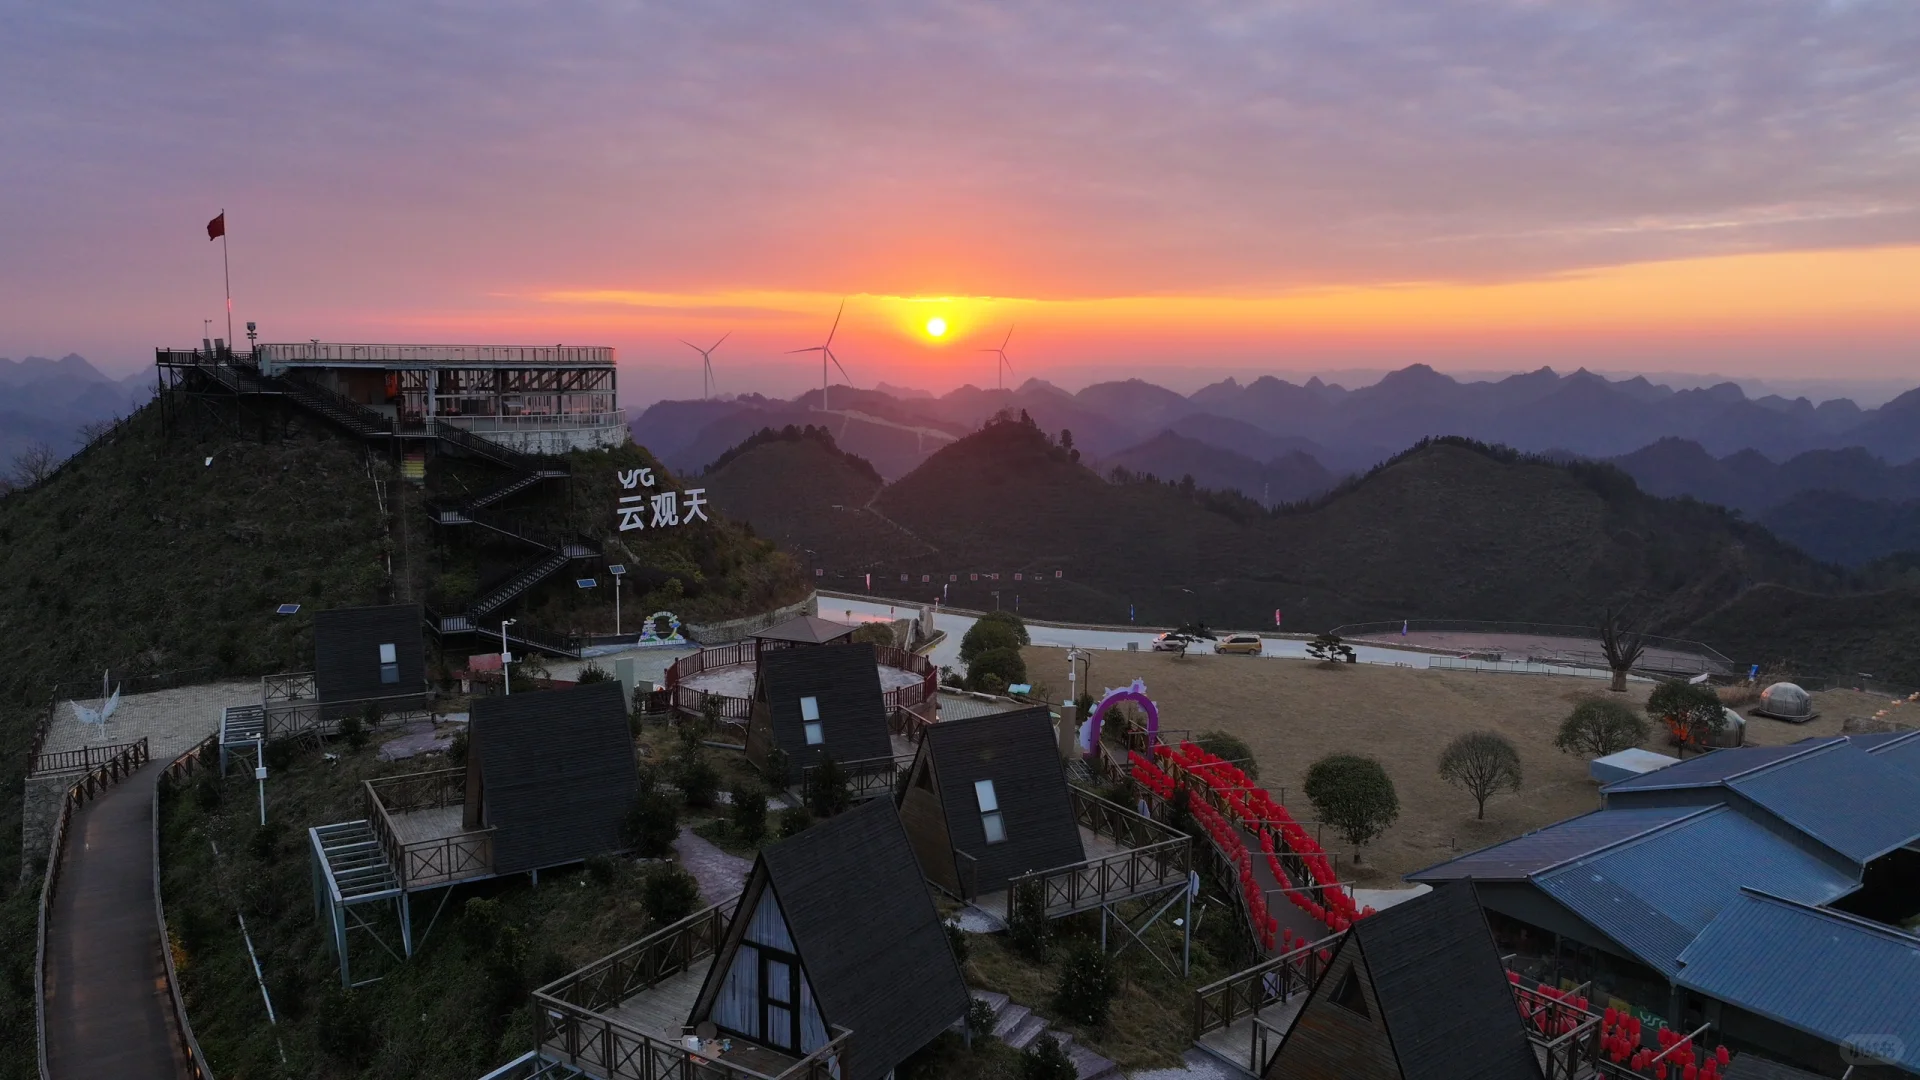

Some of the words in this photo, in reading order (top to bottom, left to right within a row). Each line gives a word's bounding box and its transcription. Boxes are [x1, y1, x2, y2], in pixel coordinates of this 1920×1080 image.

[618, 467, 655, 489] YSG
[617, 488, 708, 532] 云观天
